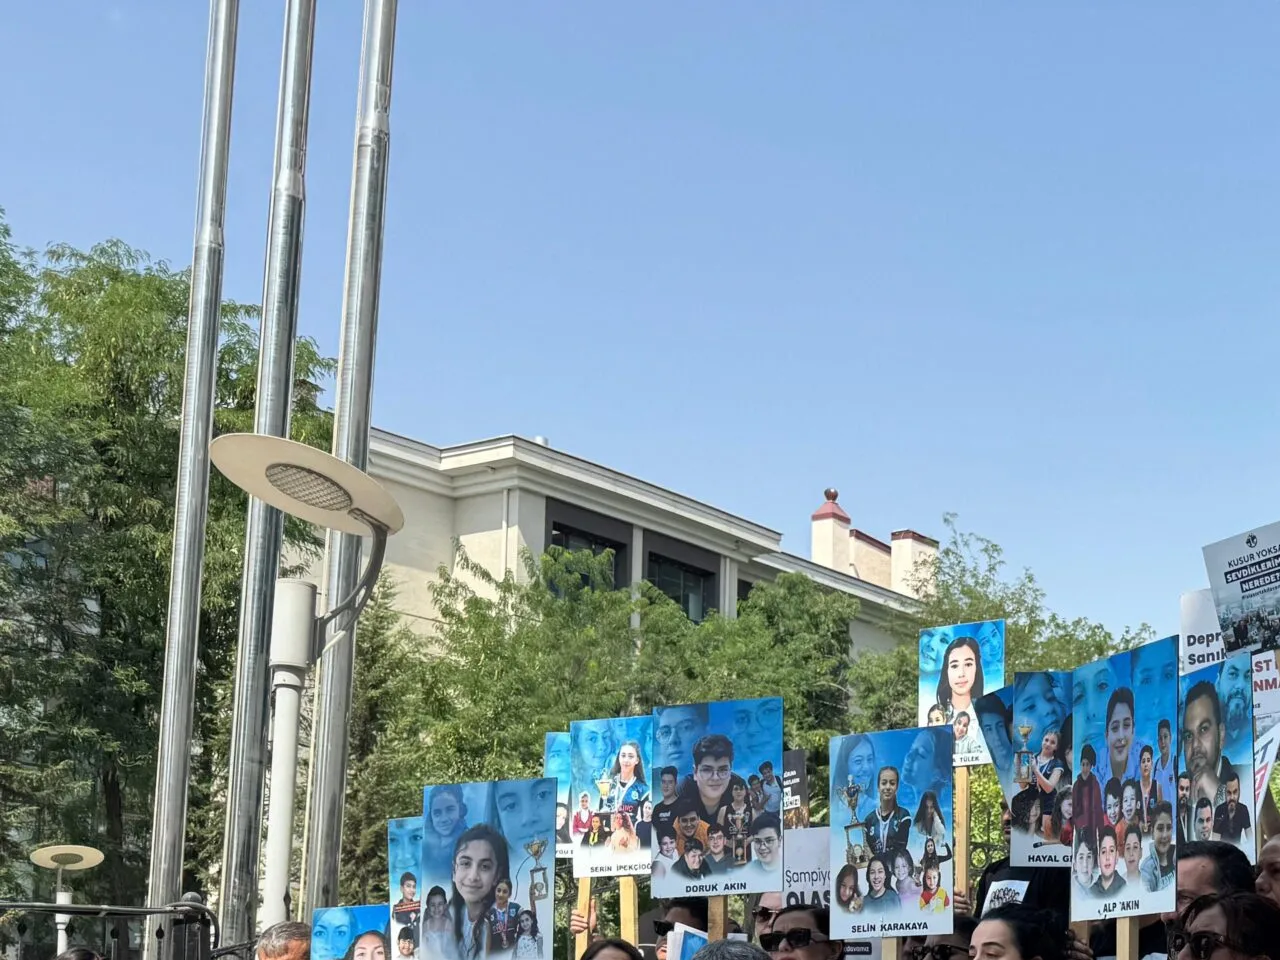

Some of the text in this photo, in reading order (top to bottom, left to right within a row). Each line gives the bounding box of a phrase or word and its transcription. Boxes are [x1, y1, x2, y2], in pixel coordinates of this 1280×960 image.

[1228, 554, 1255, 568] KUSUR
[1242, 573, 1280, 593] NEREDE?
[1028, 855, 1059, 863] HAYAL
[590, 864, 612, 873] SERİN
[685, 882, 747, 893] DORUK AKIN
[1103, 900, 1140, 913] ALP AKIN
[851, 922, 928, 933] SELİN KARAKAYA
